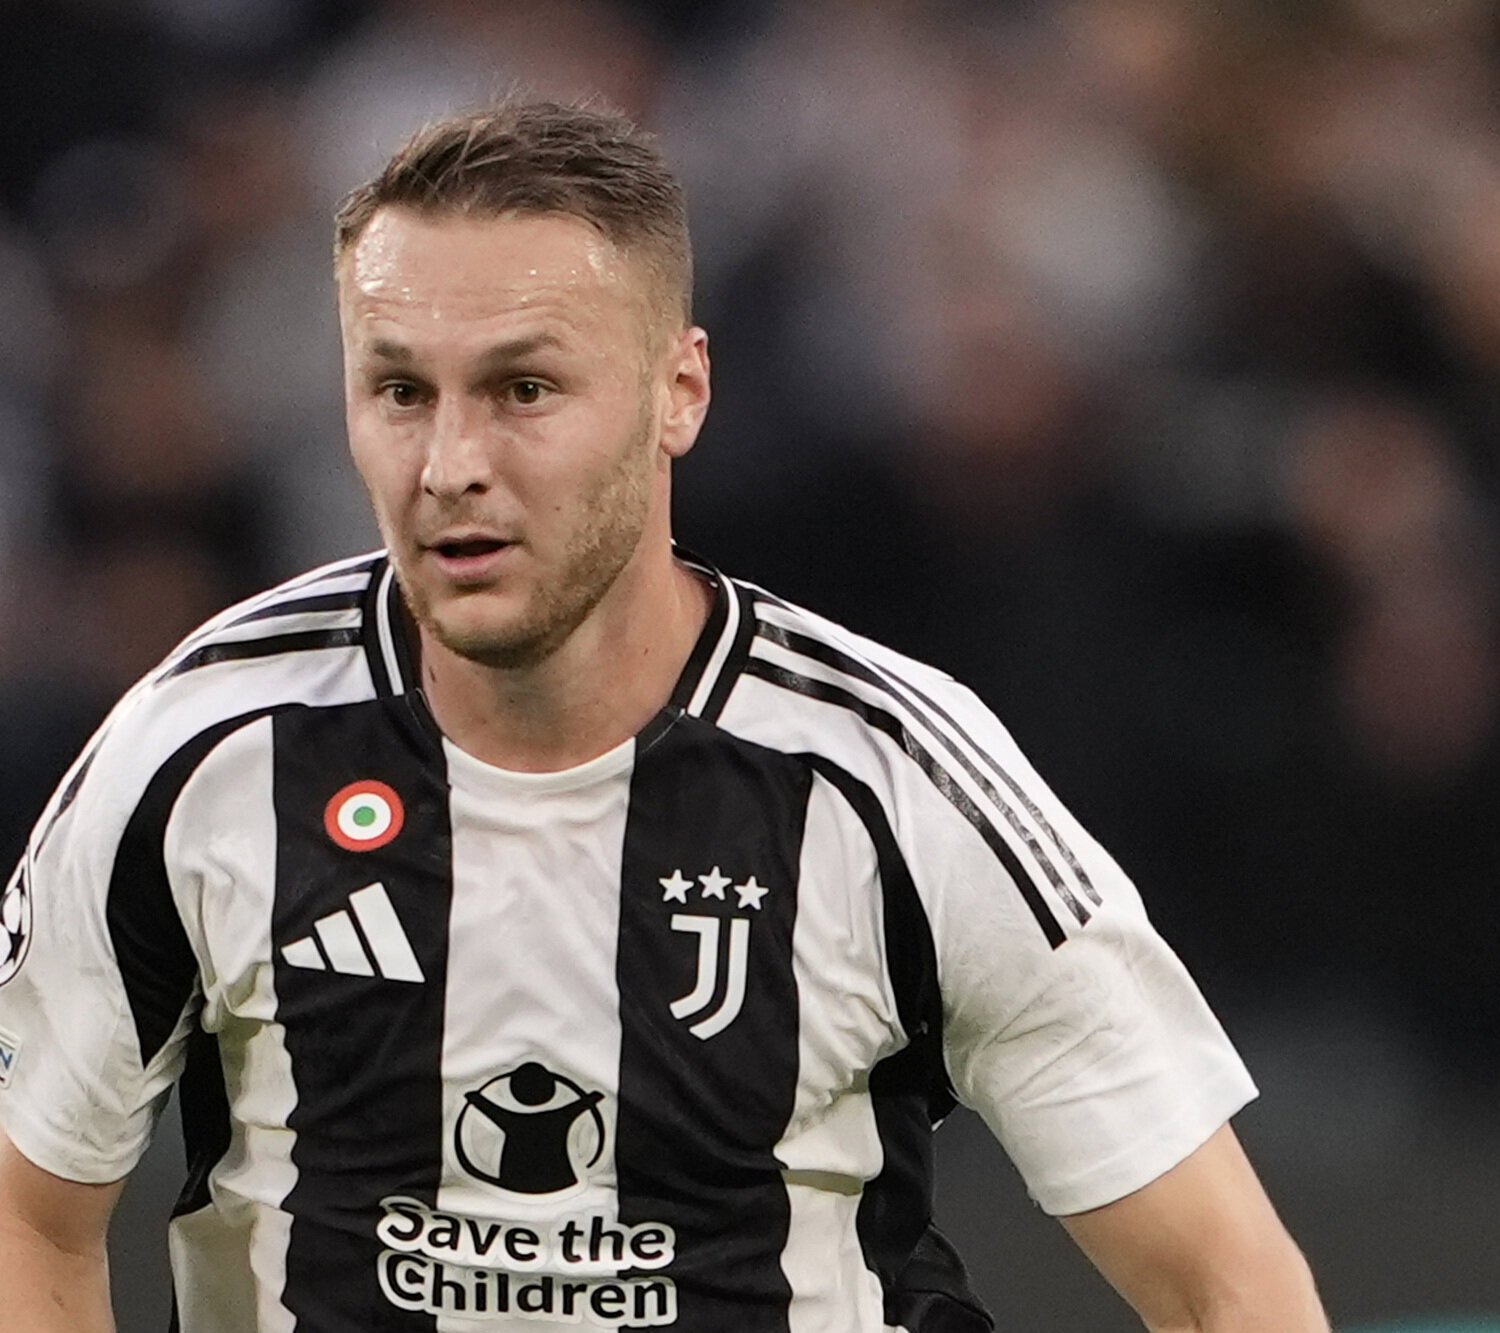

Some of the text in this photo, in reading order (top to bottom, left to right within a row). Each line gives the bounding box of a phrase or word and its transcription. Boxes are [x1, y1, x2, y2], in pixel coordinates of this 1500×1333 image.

[384, 1202, 668, 1264] Save the
[385, 1252, 670, 1320] Children
